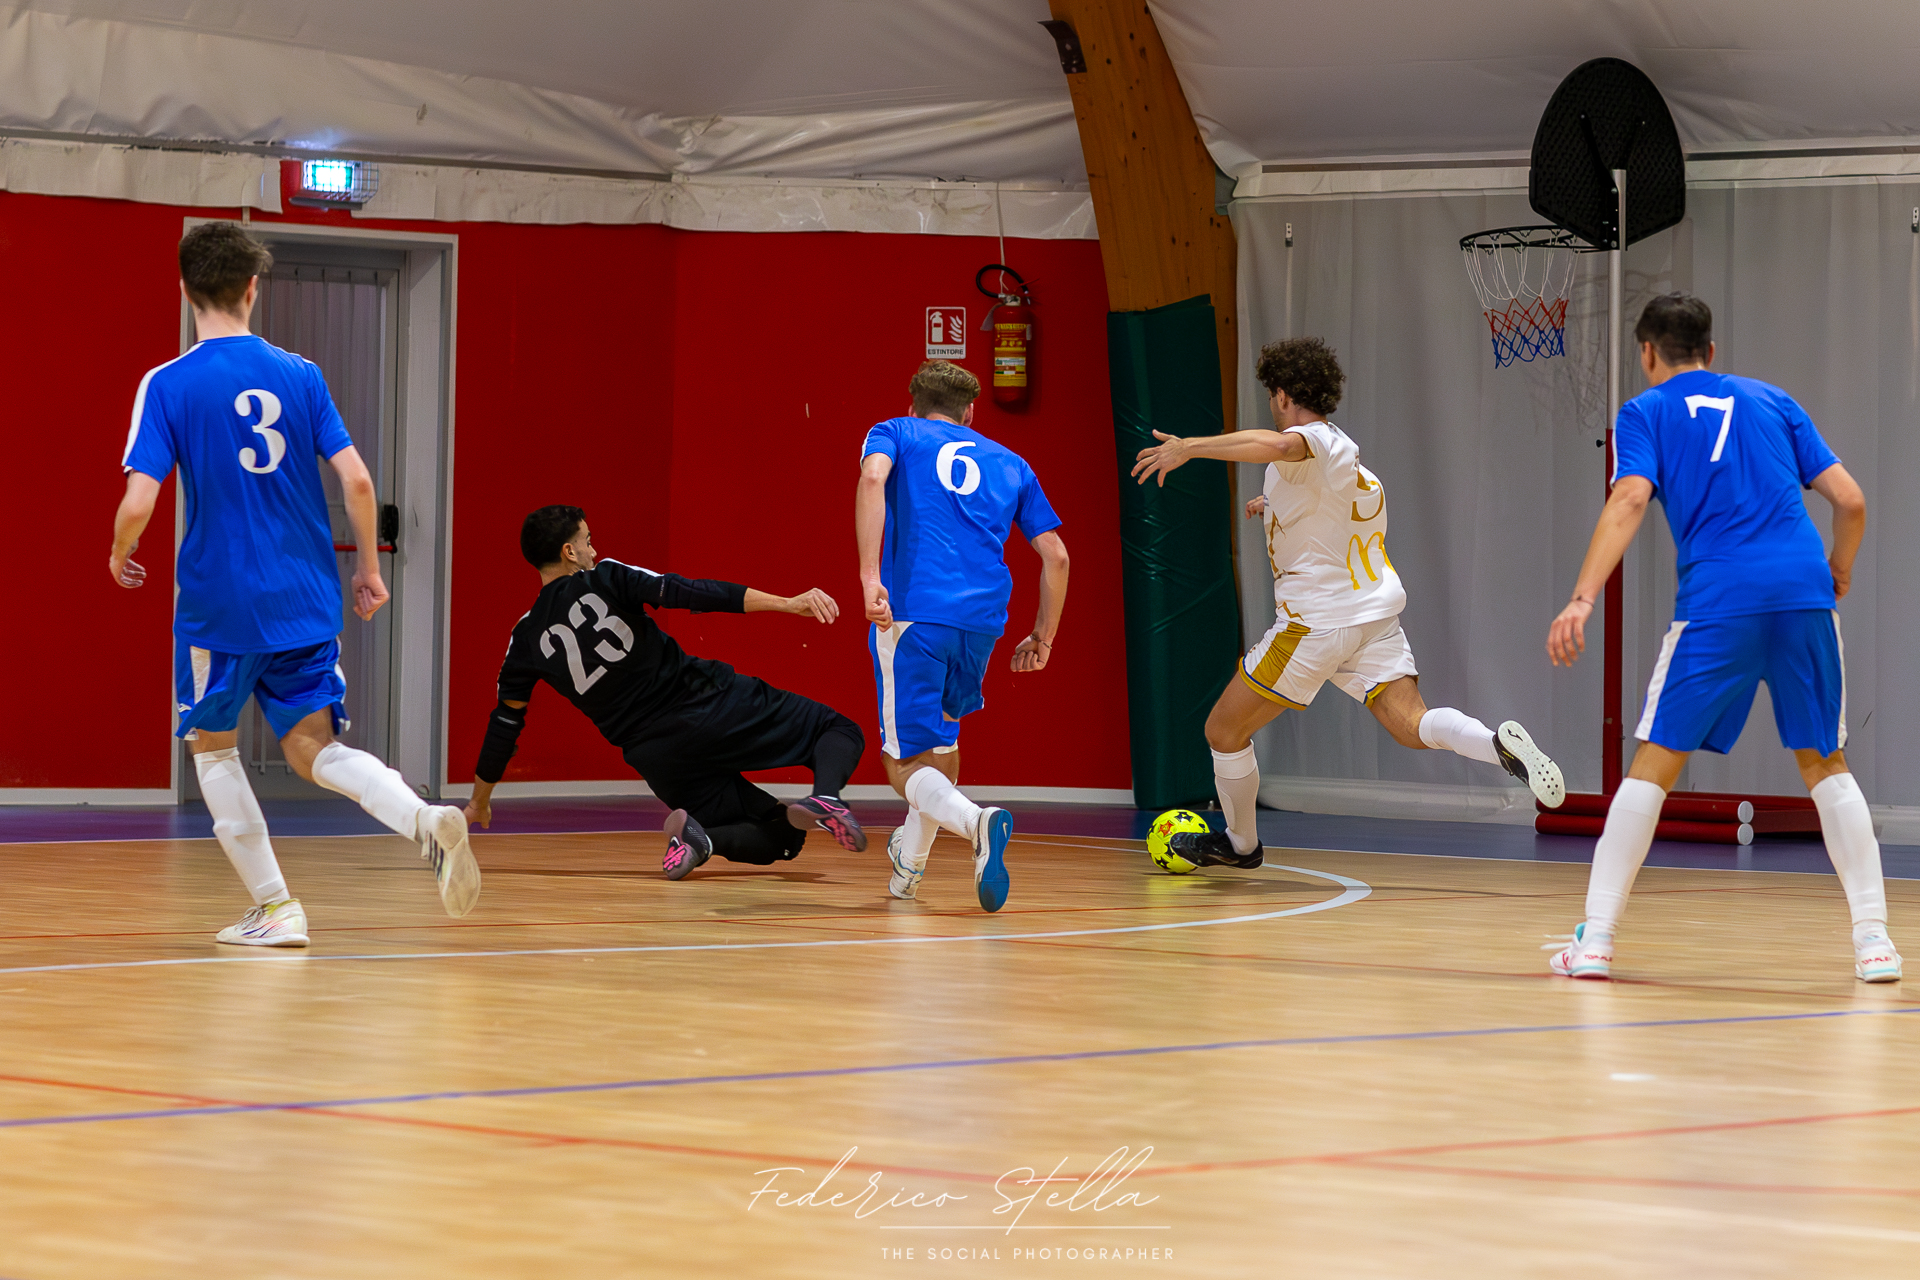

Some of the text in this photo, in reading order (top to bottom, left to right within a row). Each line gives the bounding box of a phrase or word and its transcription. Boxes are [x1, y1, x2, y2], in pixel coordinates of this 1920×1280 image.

[235, 388, 286, 474] 3
[1684, 394, 1735, 463] 7
[936, 440, 981, 496] 6
[539, 592, 635, 696] 23
